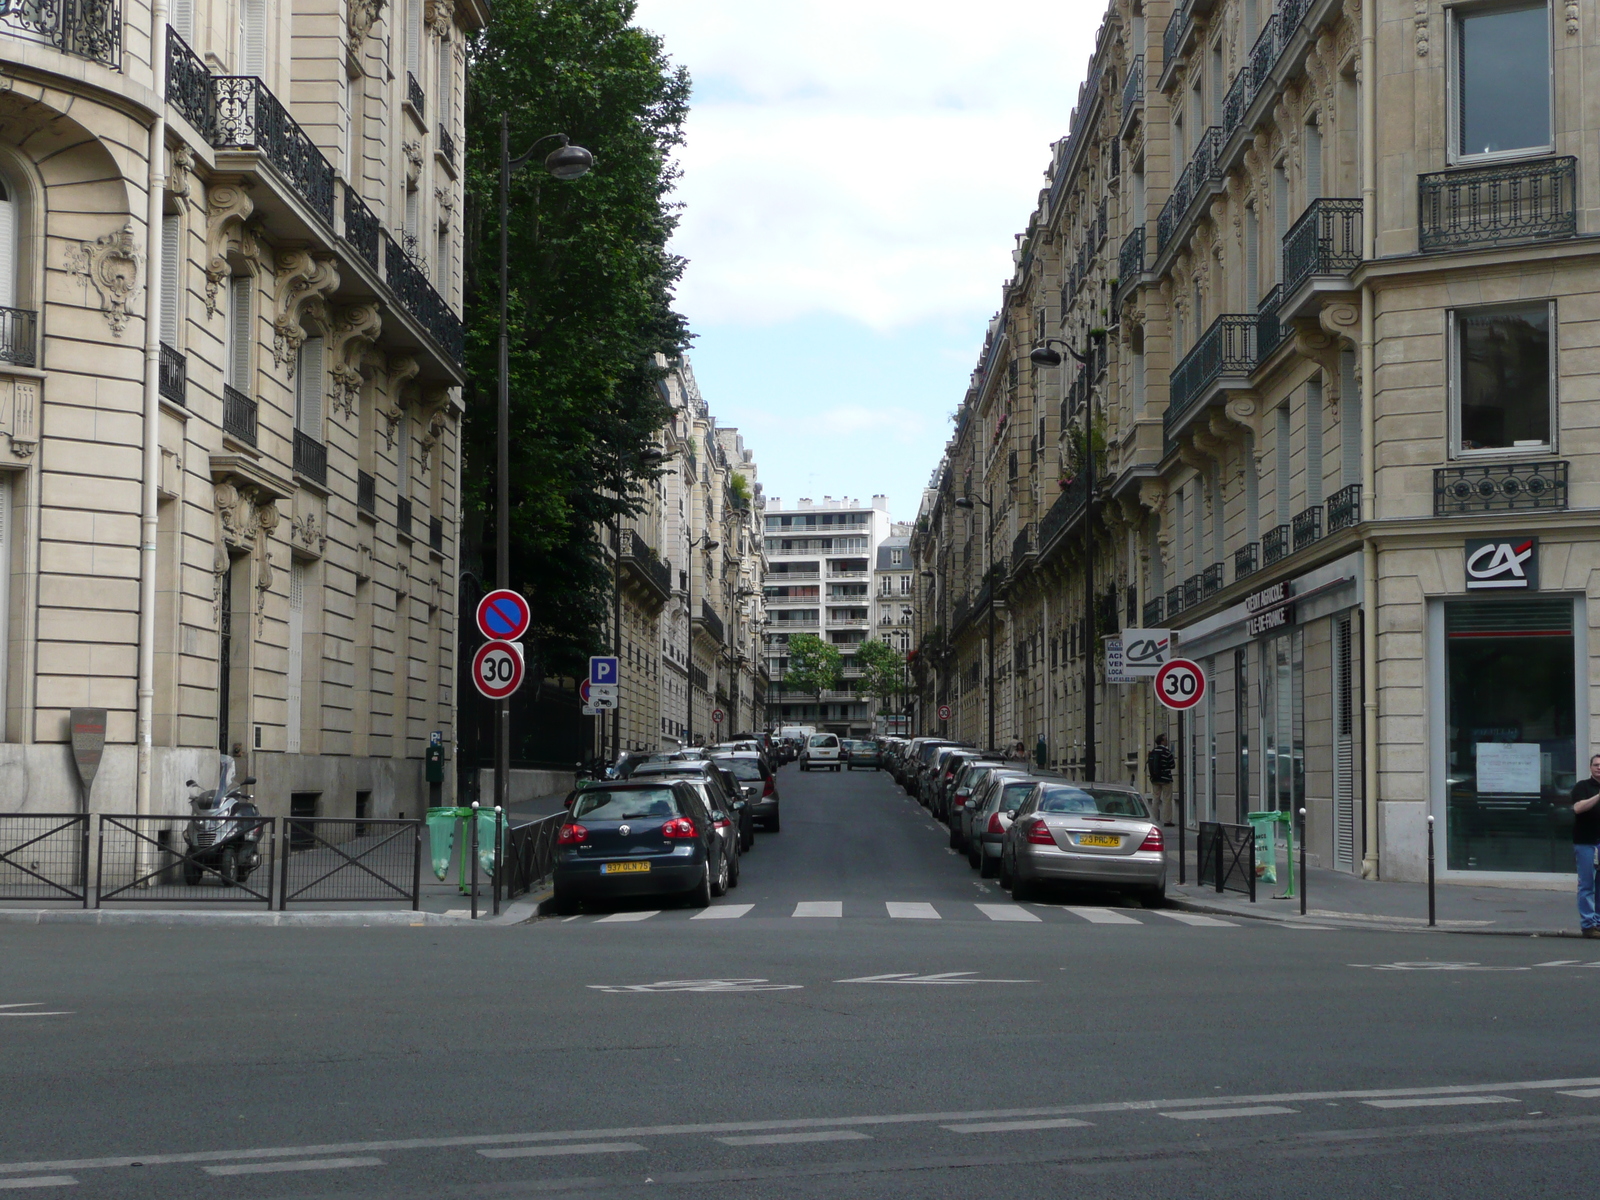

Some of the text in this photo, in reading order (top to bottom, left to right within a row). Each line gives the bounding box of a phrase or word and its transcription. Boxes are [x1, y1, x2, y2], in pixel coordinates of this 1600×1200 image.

[483, 657, 513, 682] 30
[597, 662, 610, 680] P
[1165, 673, 1196, 695] 30
[1109, 837, 1119, 845] 75
[639, 862, 648, 870] 75
